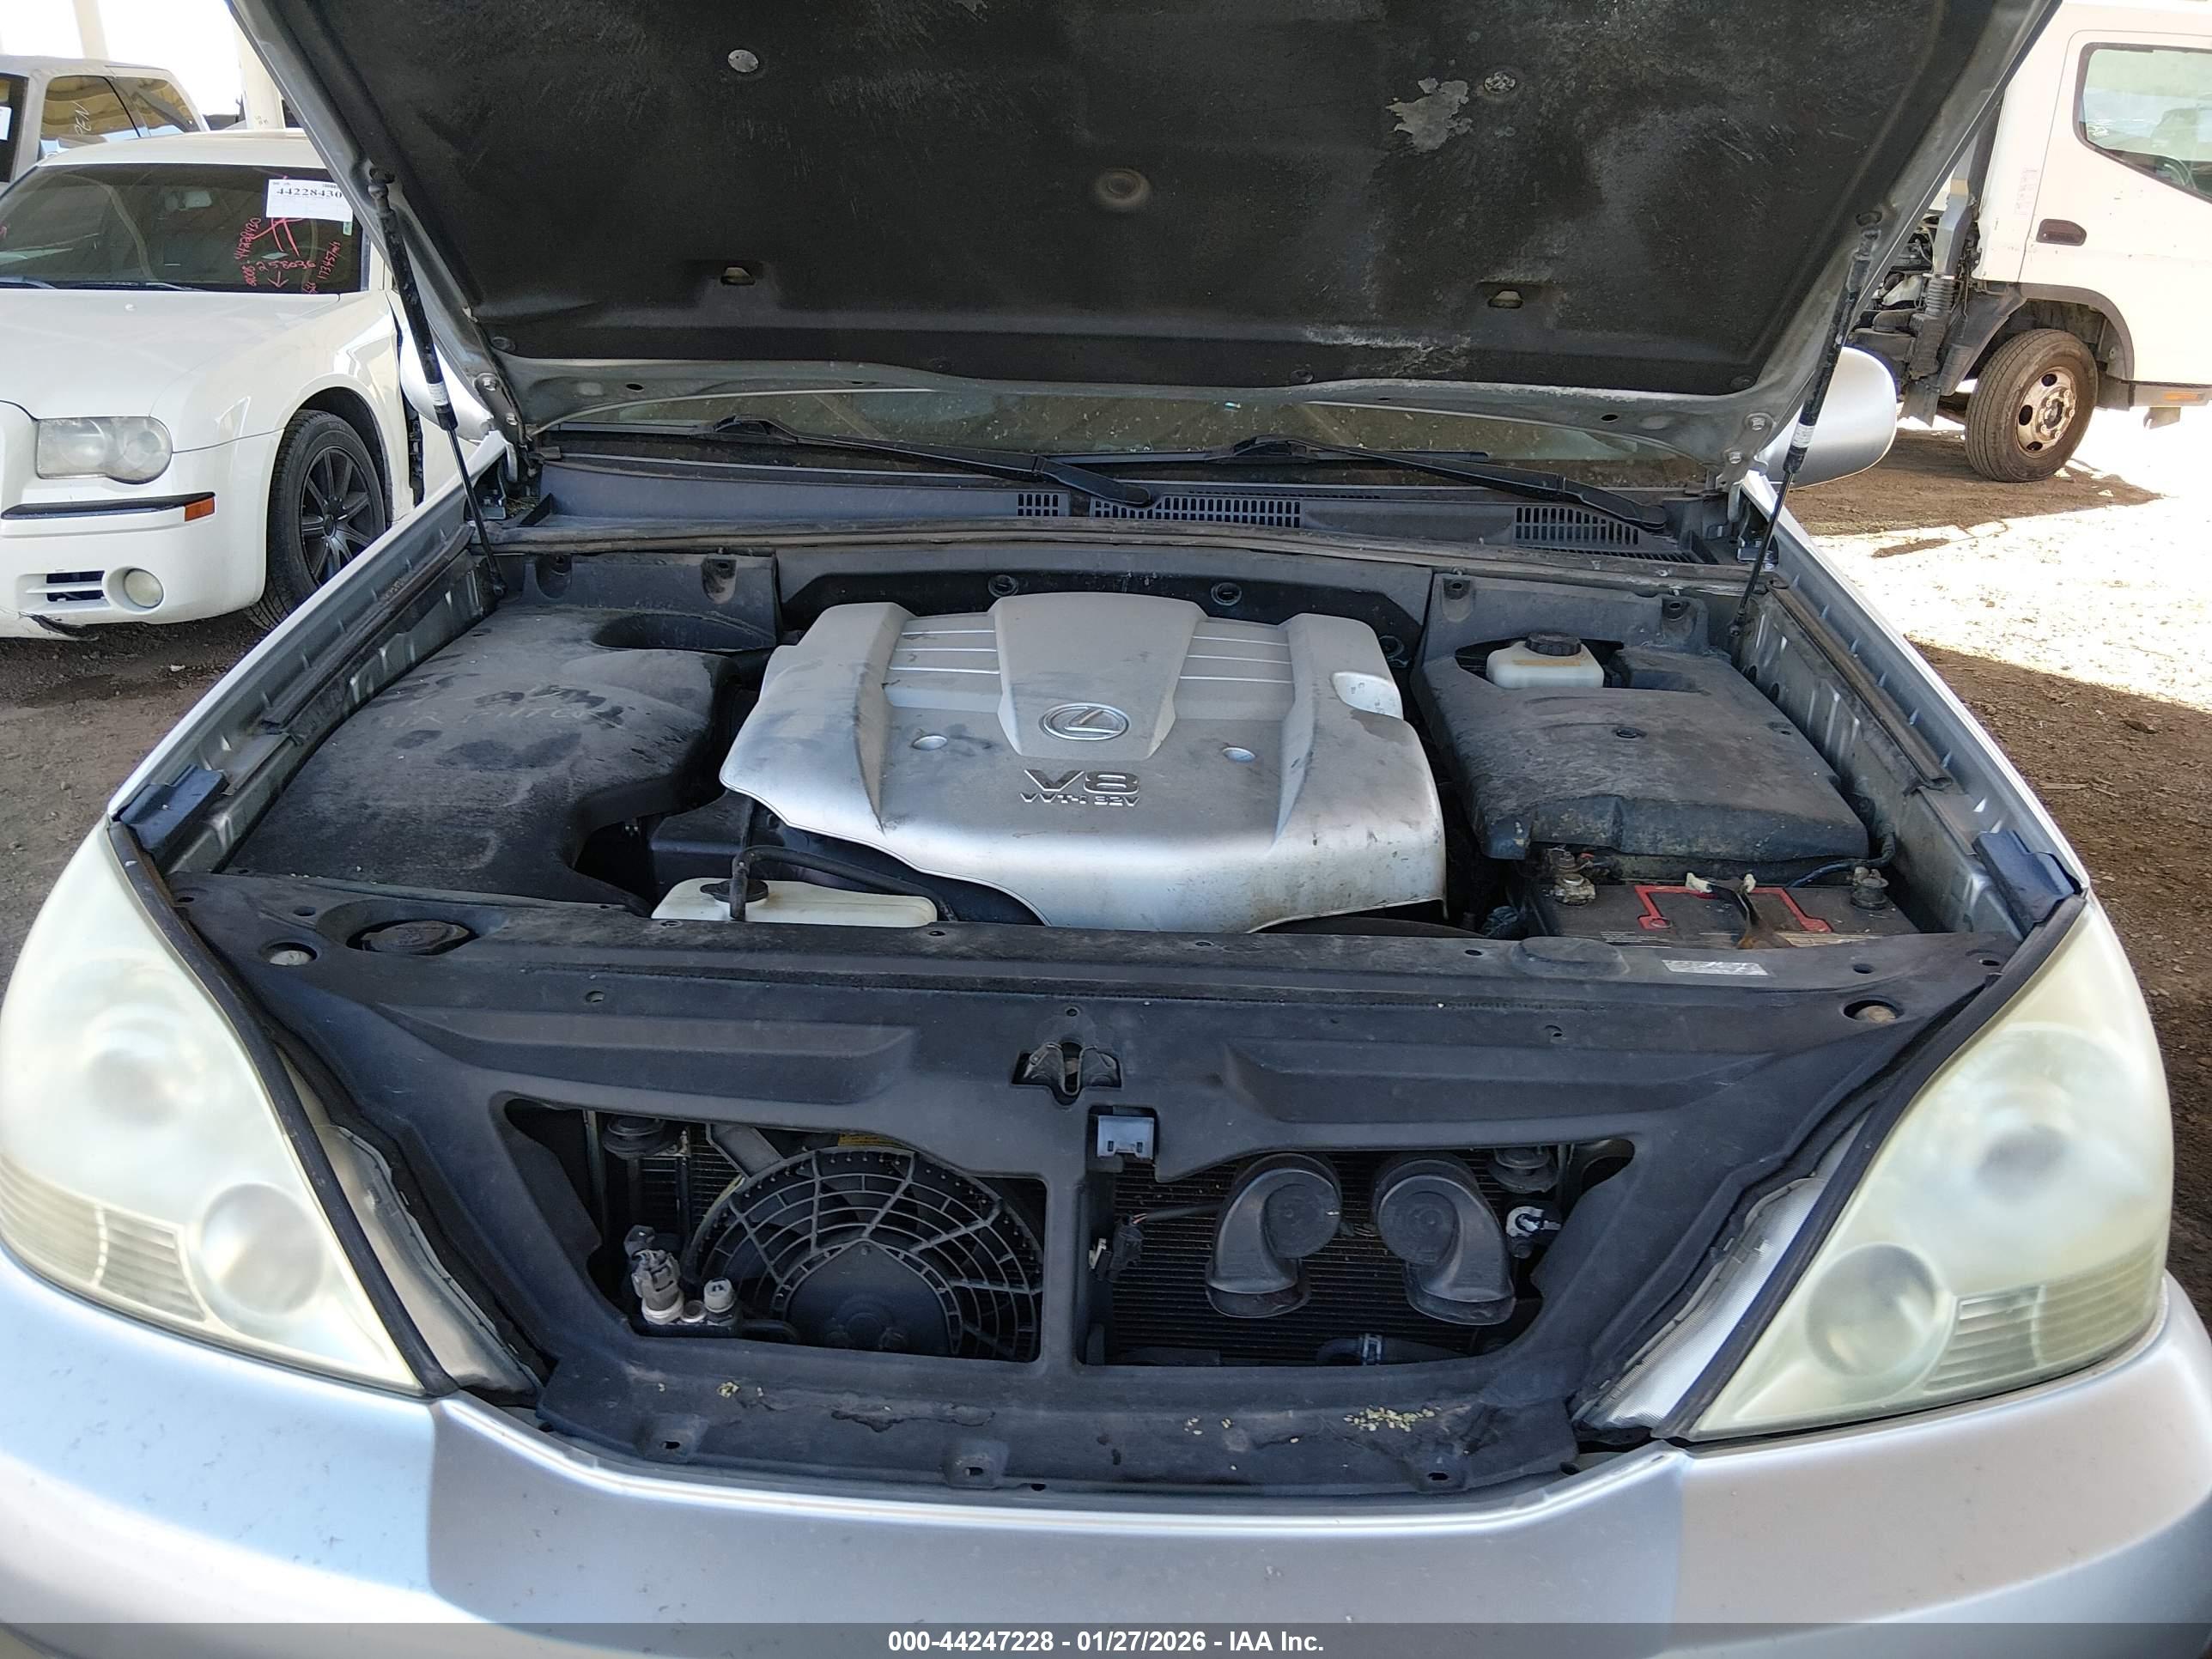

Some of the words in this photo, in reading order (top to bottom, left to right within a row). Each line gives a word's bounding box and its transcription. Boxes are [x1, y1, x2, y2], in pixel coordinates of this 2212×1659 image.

[276, 187, 343, 199] 44228430
[1024, 769, 1139, 794] V8
[1094, 795, 1140, 807] 32V
